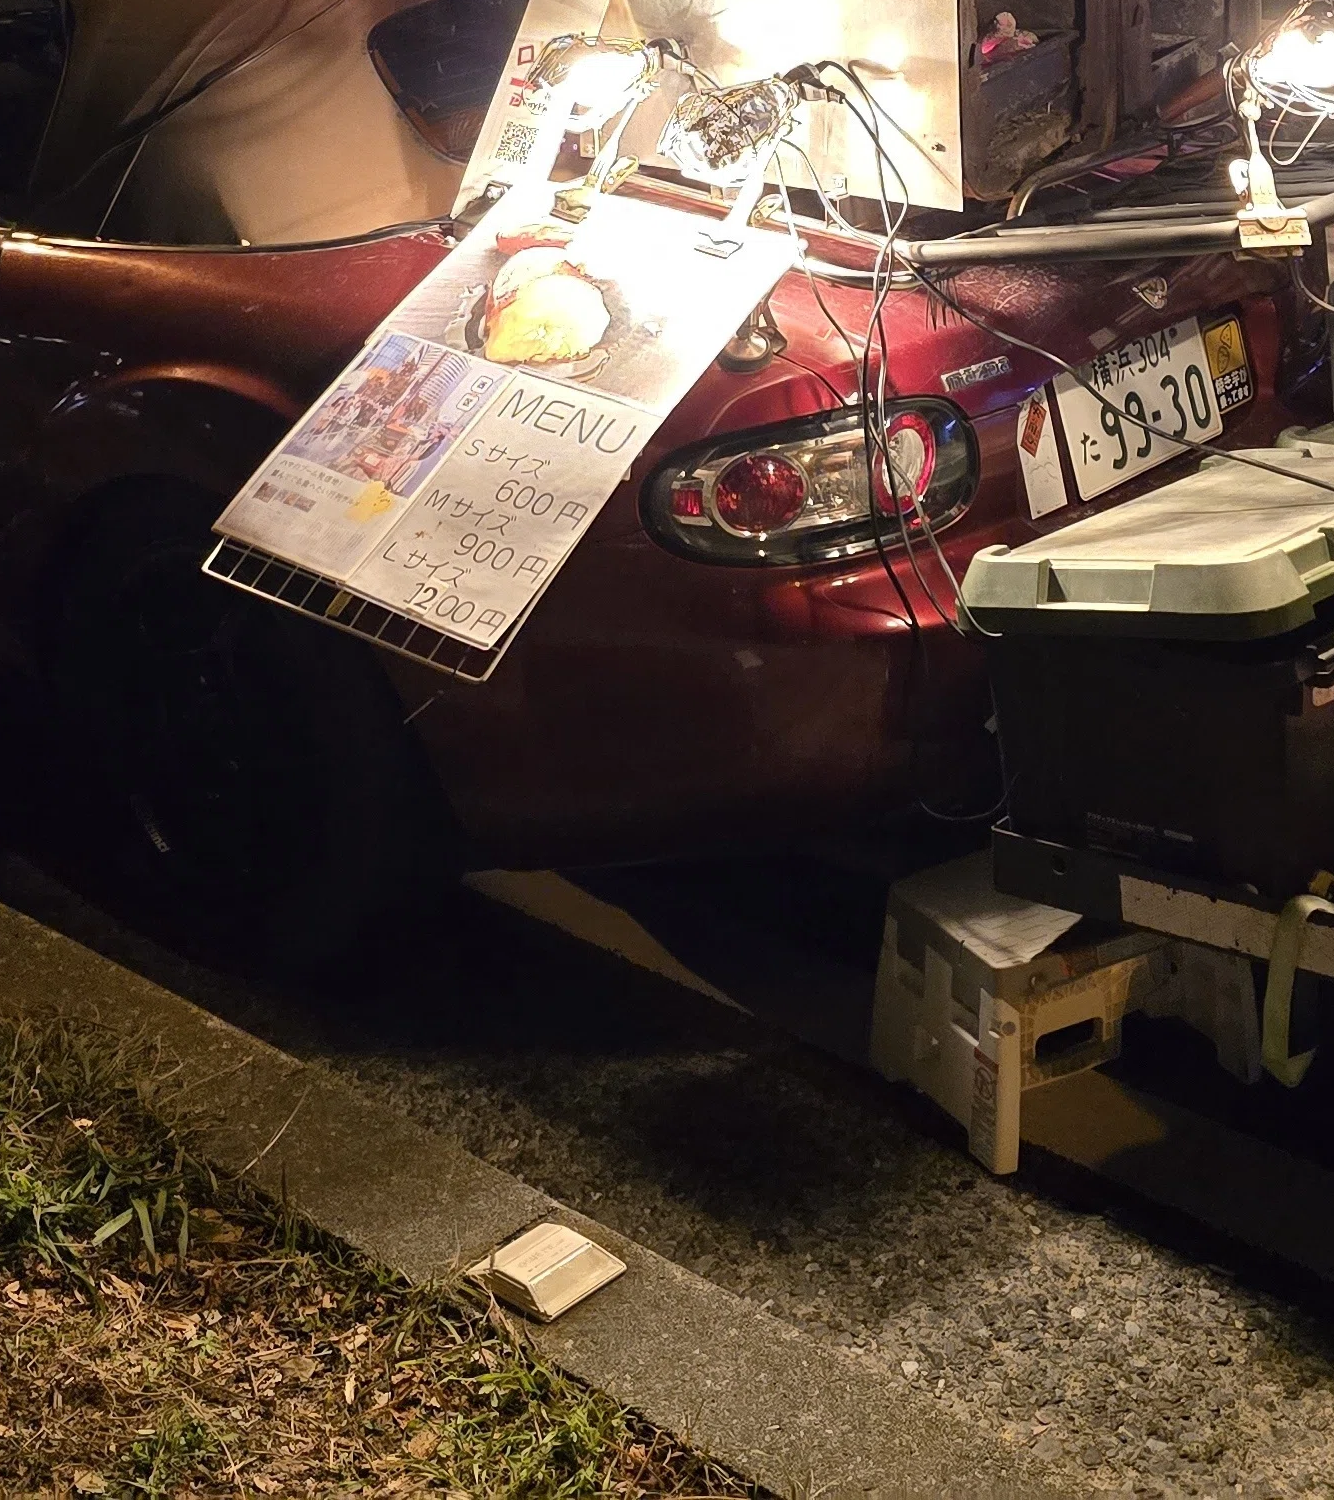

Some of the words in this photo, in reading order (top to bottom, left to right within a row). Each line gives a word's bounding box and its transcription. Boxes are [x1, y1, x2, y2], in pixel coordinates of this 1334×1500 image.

[1091, 352, 1136, 392] 横浜
[1132, 328, 1172, 374] 304
[498, 388, 636, 454] MENU
[1080, 431, 1102, 466] た
[1100, 364, 1212, 470] 99-30
[495, 479, 589, 531] 600円
[453, 532, 549, 584] 900円
[403, 582, 507, 638] 1200円
